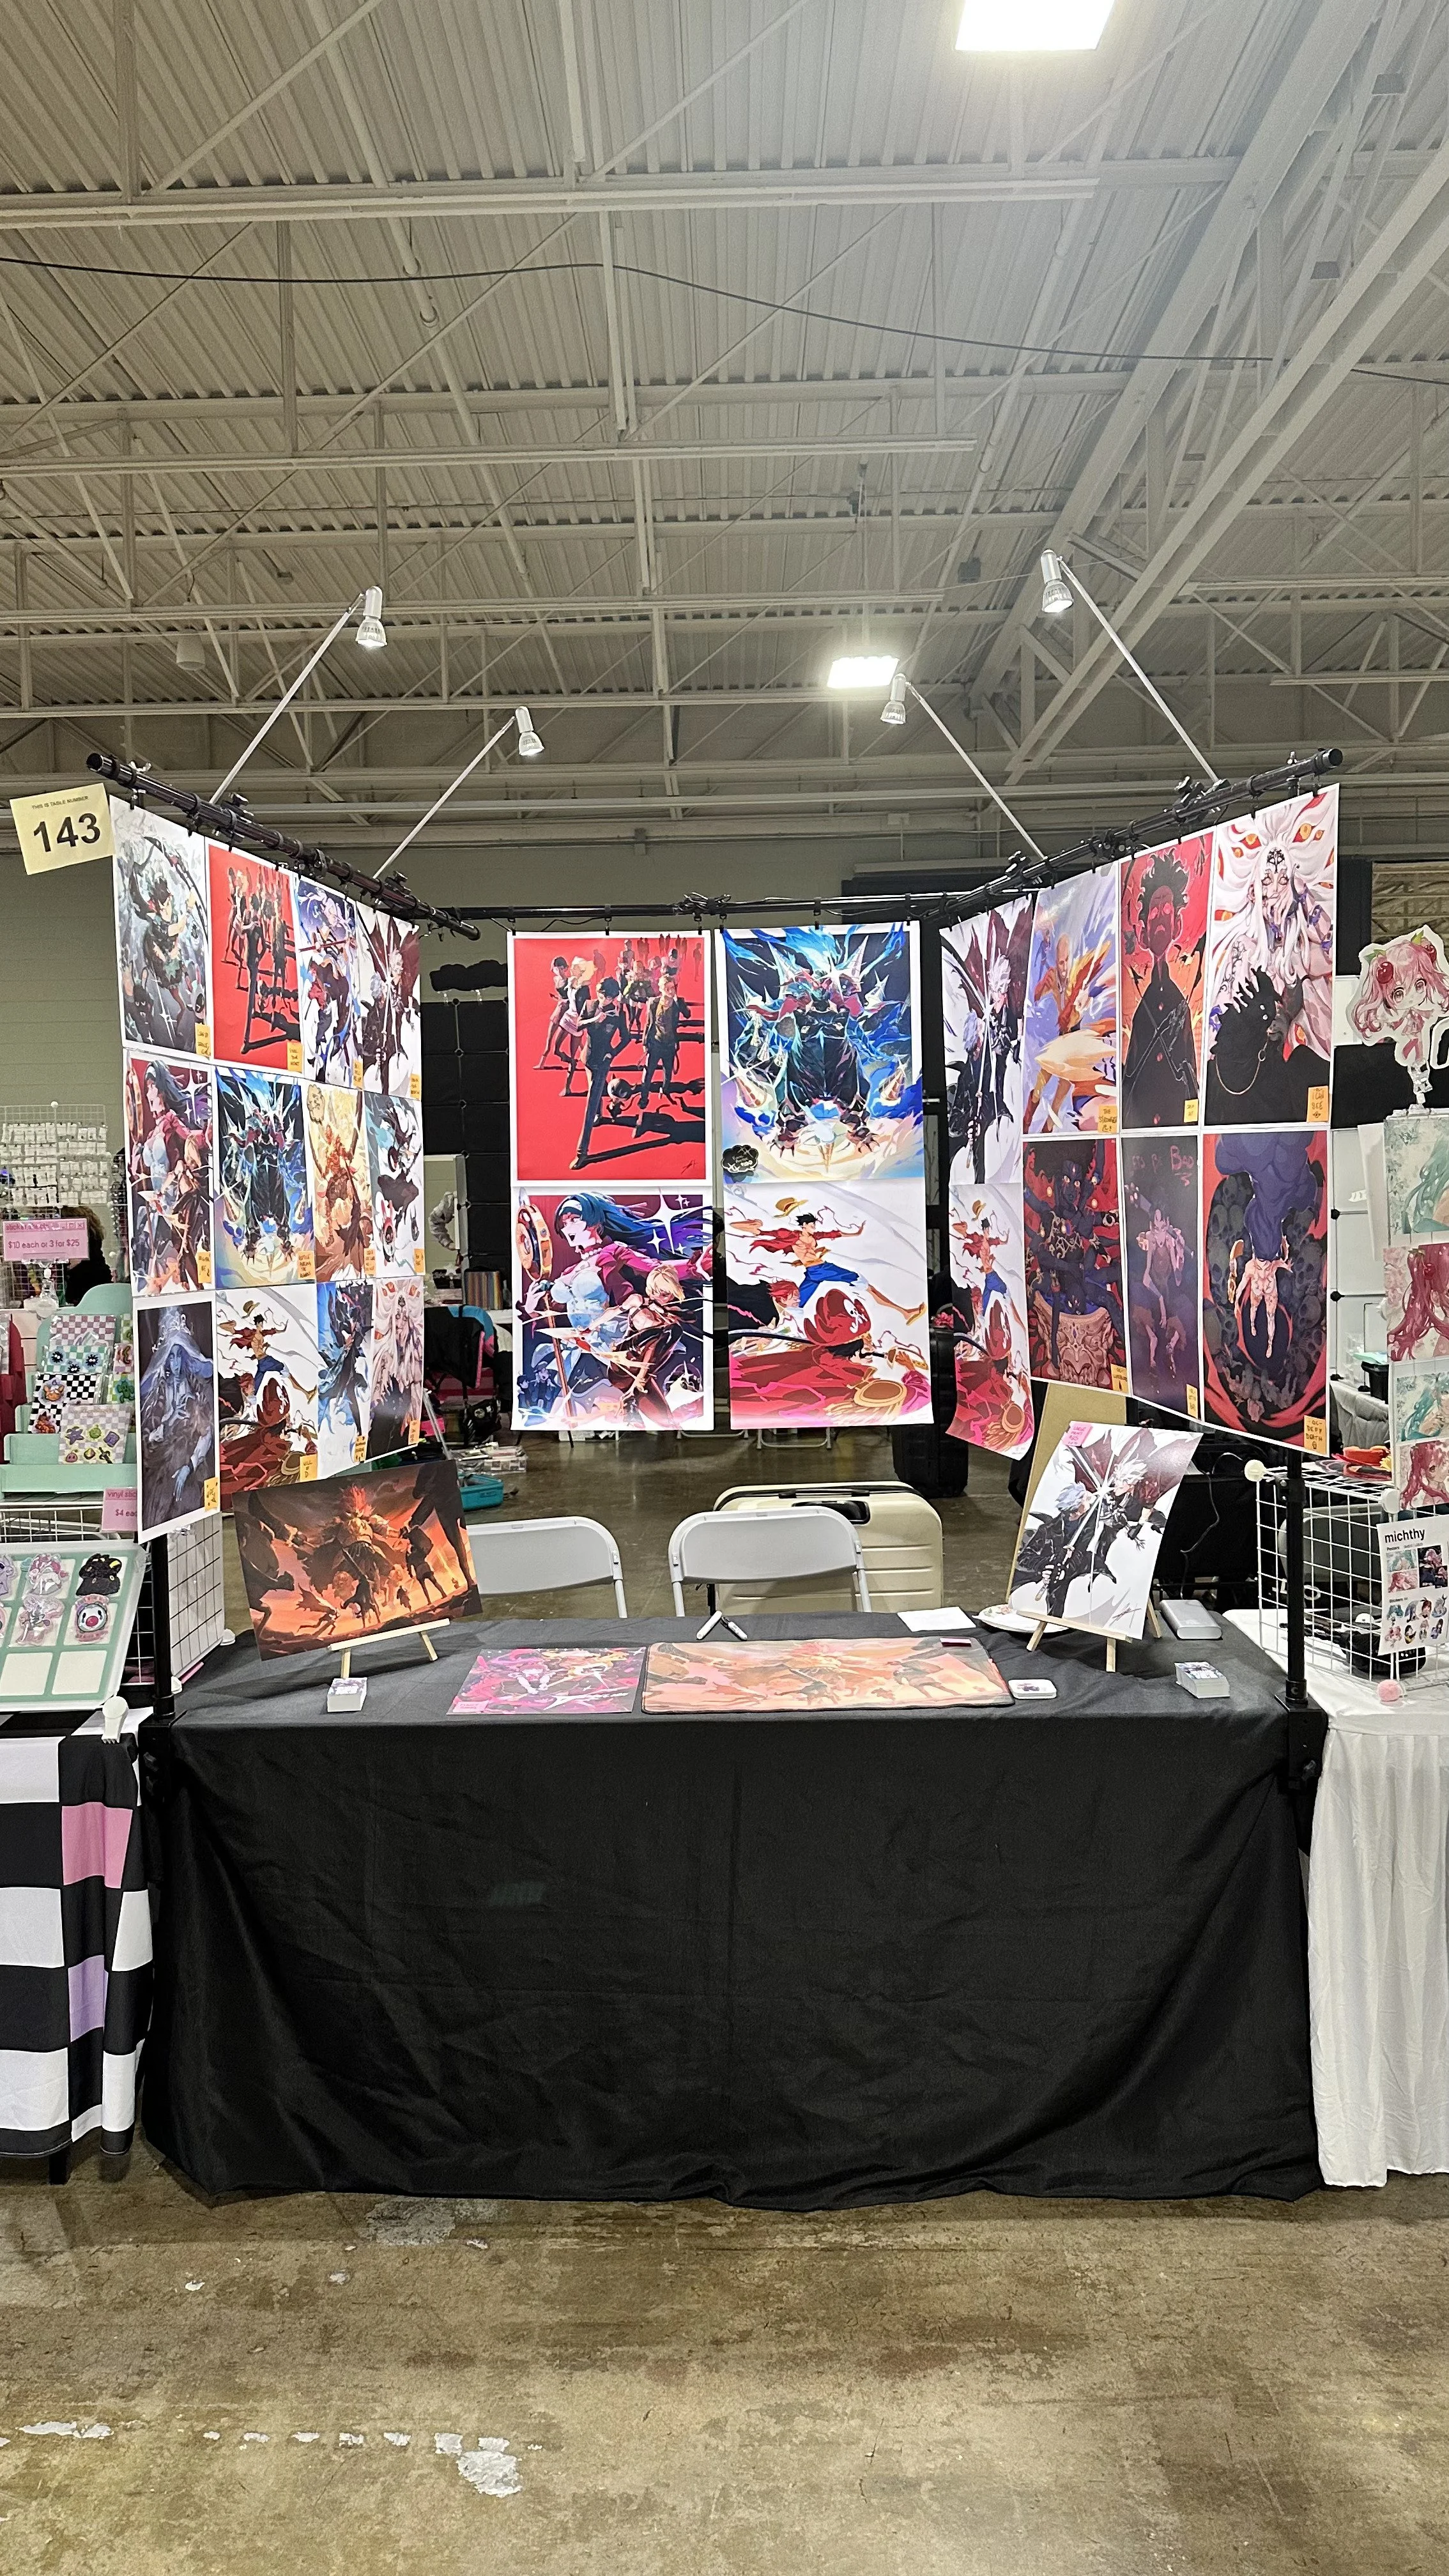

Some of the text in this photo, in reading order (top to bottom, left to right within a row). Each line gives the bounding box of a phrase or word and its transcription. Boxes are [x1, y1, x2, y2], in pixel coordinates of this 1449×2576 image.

[67, 795, 88, 804] NUMBER
[33, 813, 100, 852] 143
[8, 1241, 20, 1249] $10
[22, 1240, 39, 1248] each
[107, 1490, 123, 1498] vinyl
[1384, 1528, 1425, 1543] michthy
